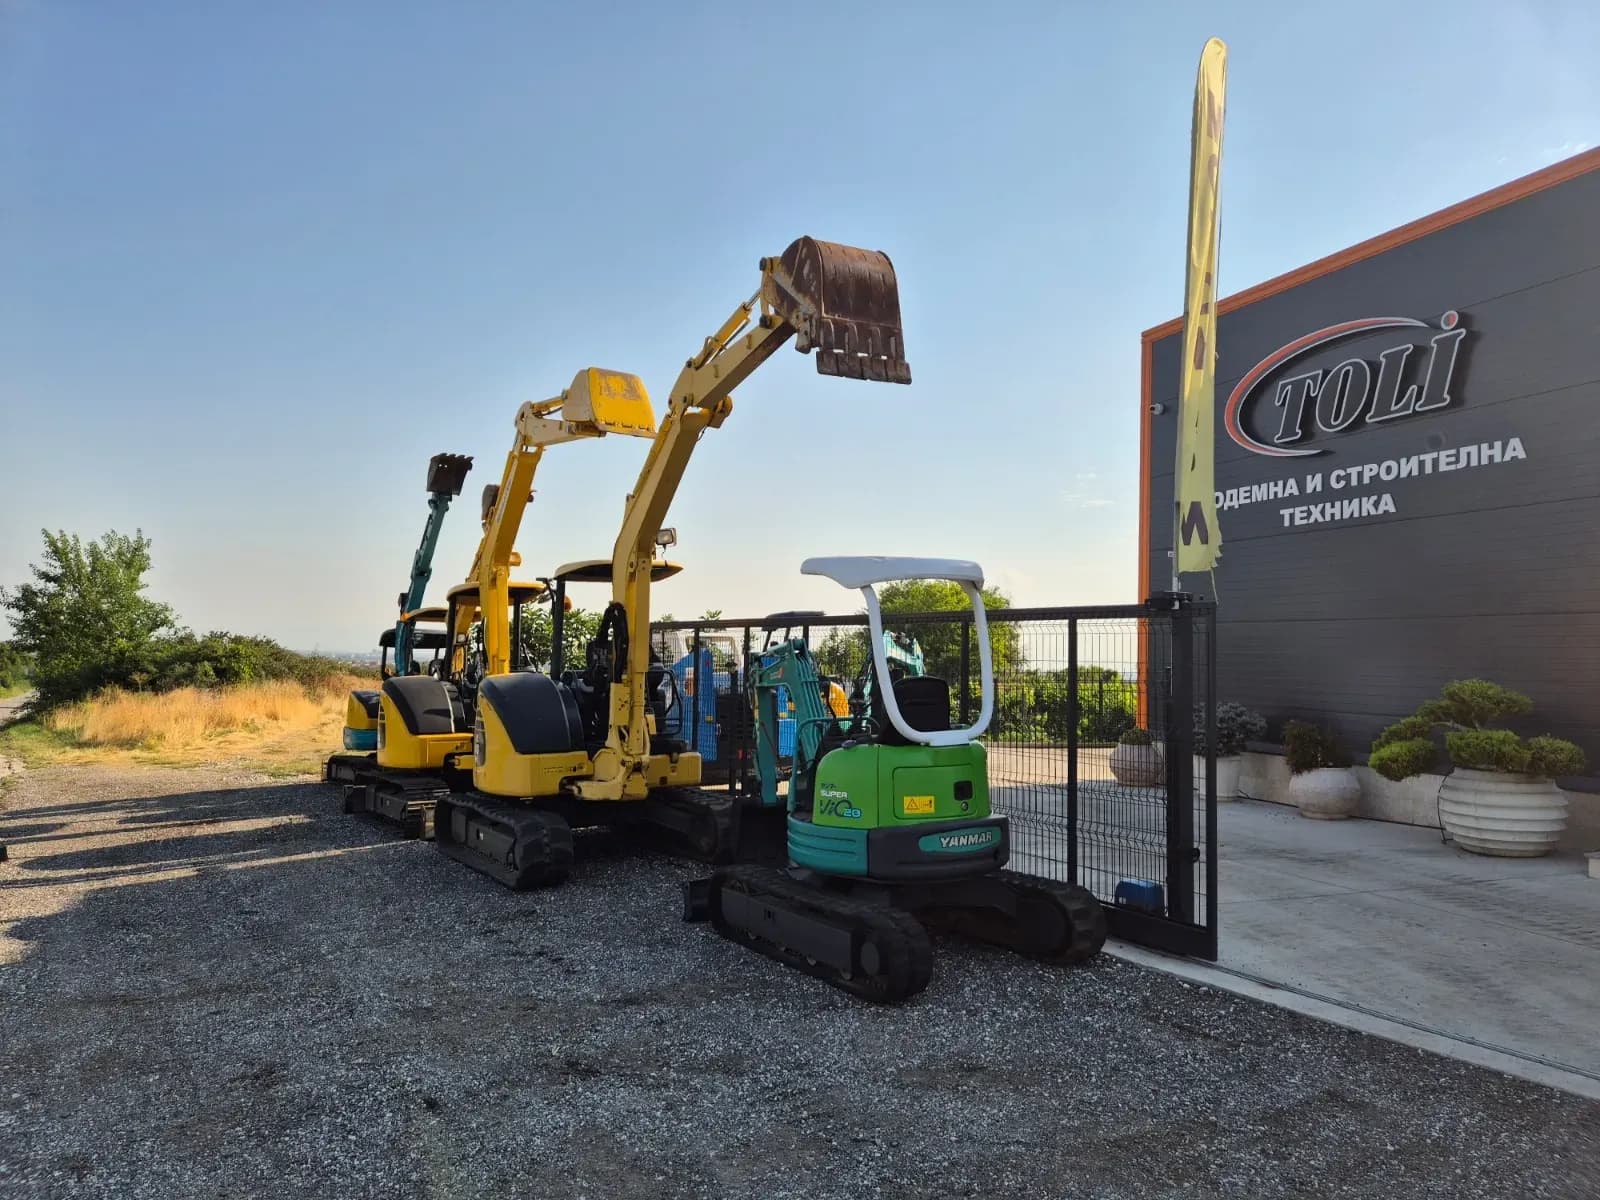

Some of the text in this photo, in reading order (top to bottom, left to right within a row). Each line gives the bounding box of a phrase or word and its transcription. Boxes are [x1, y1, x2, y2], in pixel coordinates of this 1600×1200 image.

[1214, 437, 1527, 511] ОДЕМНА И СТРОИТЕЛНА
[1280, 493, 1397, 527] ТЕХНИКА
[820, 790, 848, 799] SUPER
[940, 831, 992, 848] YANMAR
